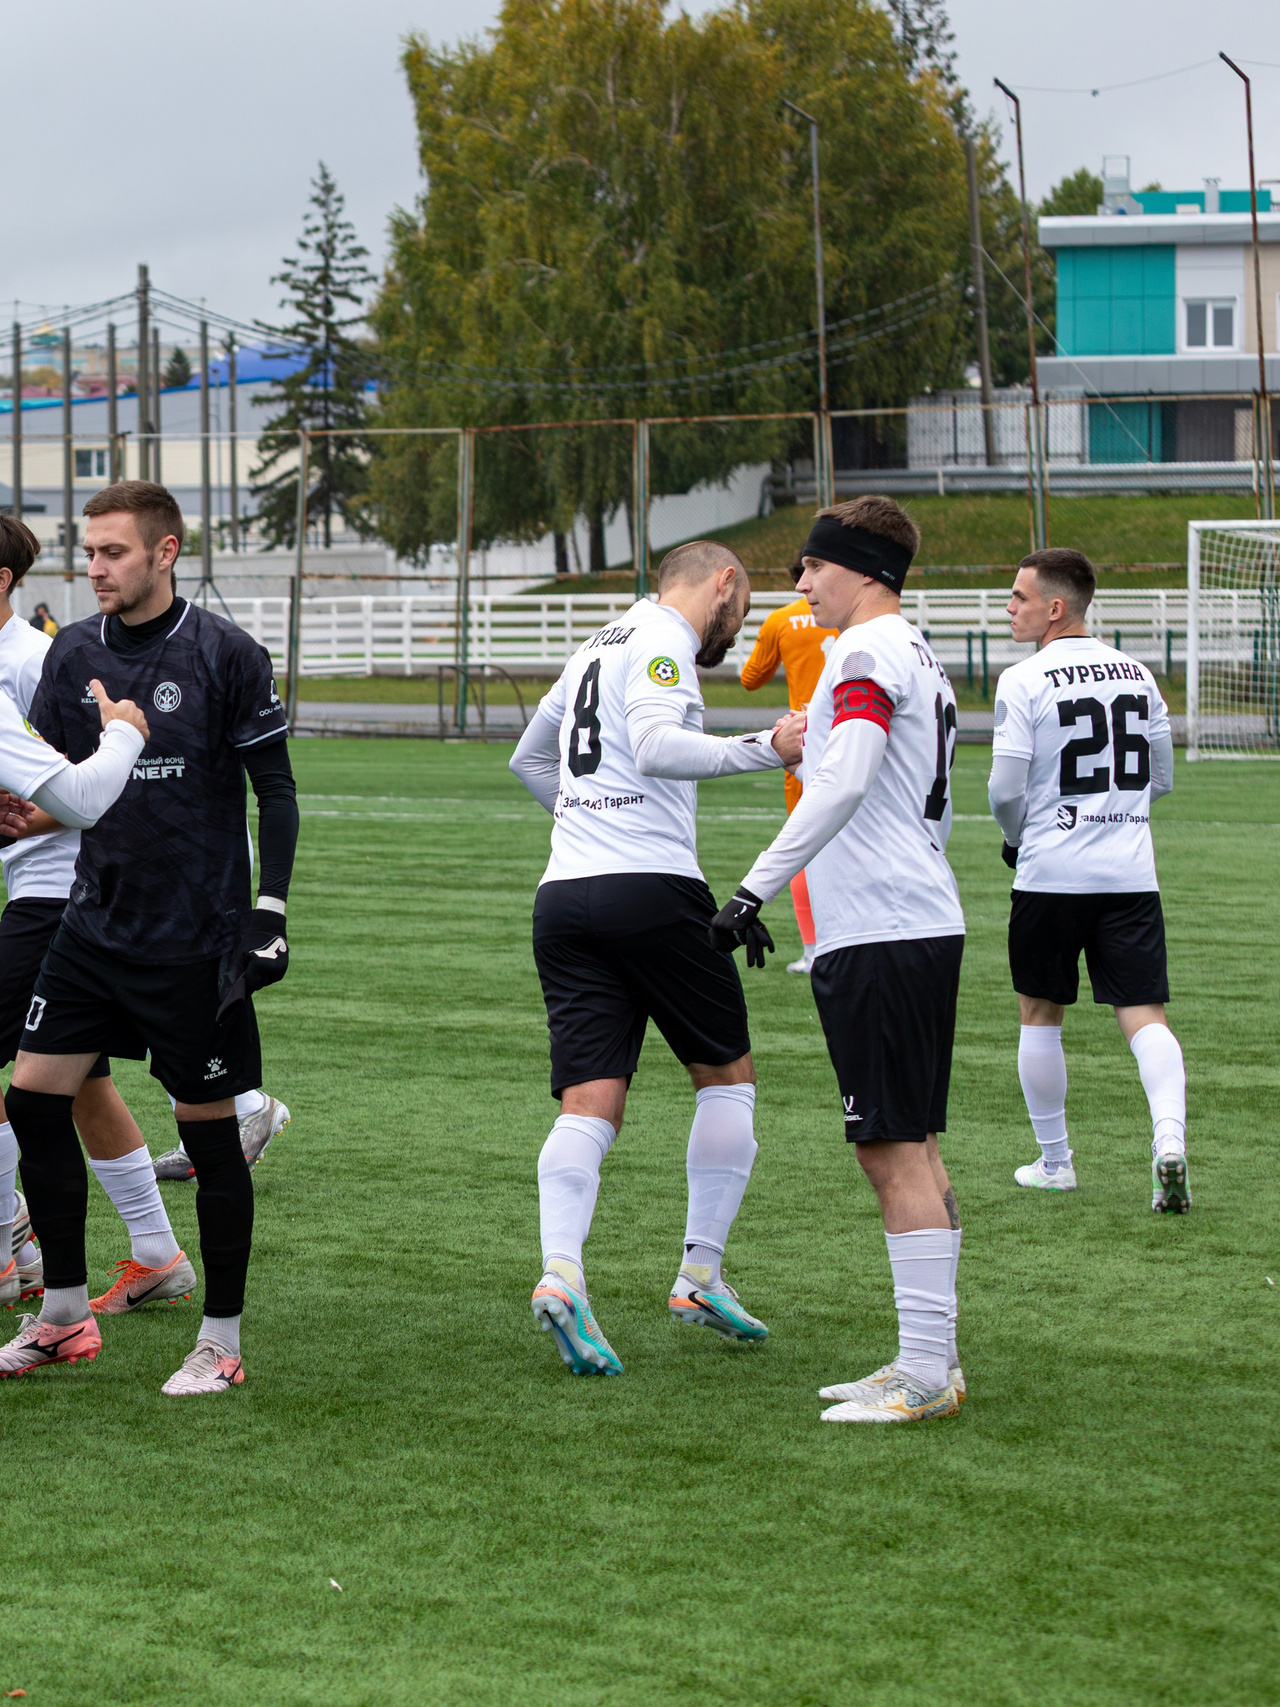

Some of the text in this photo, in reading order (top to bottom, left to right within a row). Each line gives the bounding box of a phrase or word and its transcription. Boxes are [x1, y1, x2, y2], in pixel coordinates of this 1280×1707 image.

[1044, 662, 1146, 688] ТУРБИНА
[843, 686, 869, 711] C
[567, 657, 602, 778] 8
[1056, 693, 1151, 797] 26
[164, 756, 185, 765] ФОНД
[604, 794, 645, 809] Гарант
[1080, 814, 1106, 825] авод
[1108, 812, 1123, 823] АКЗ
[203, 1068, 228, 1081] KELME
